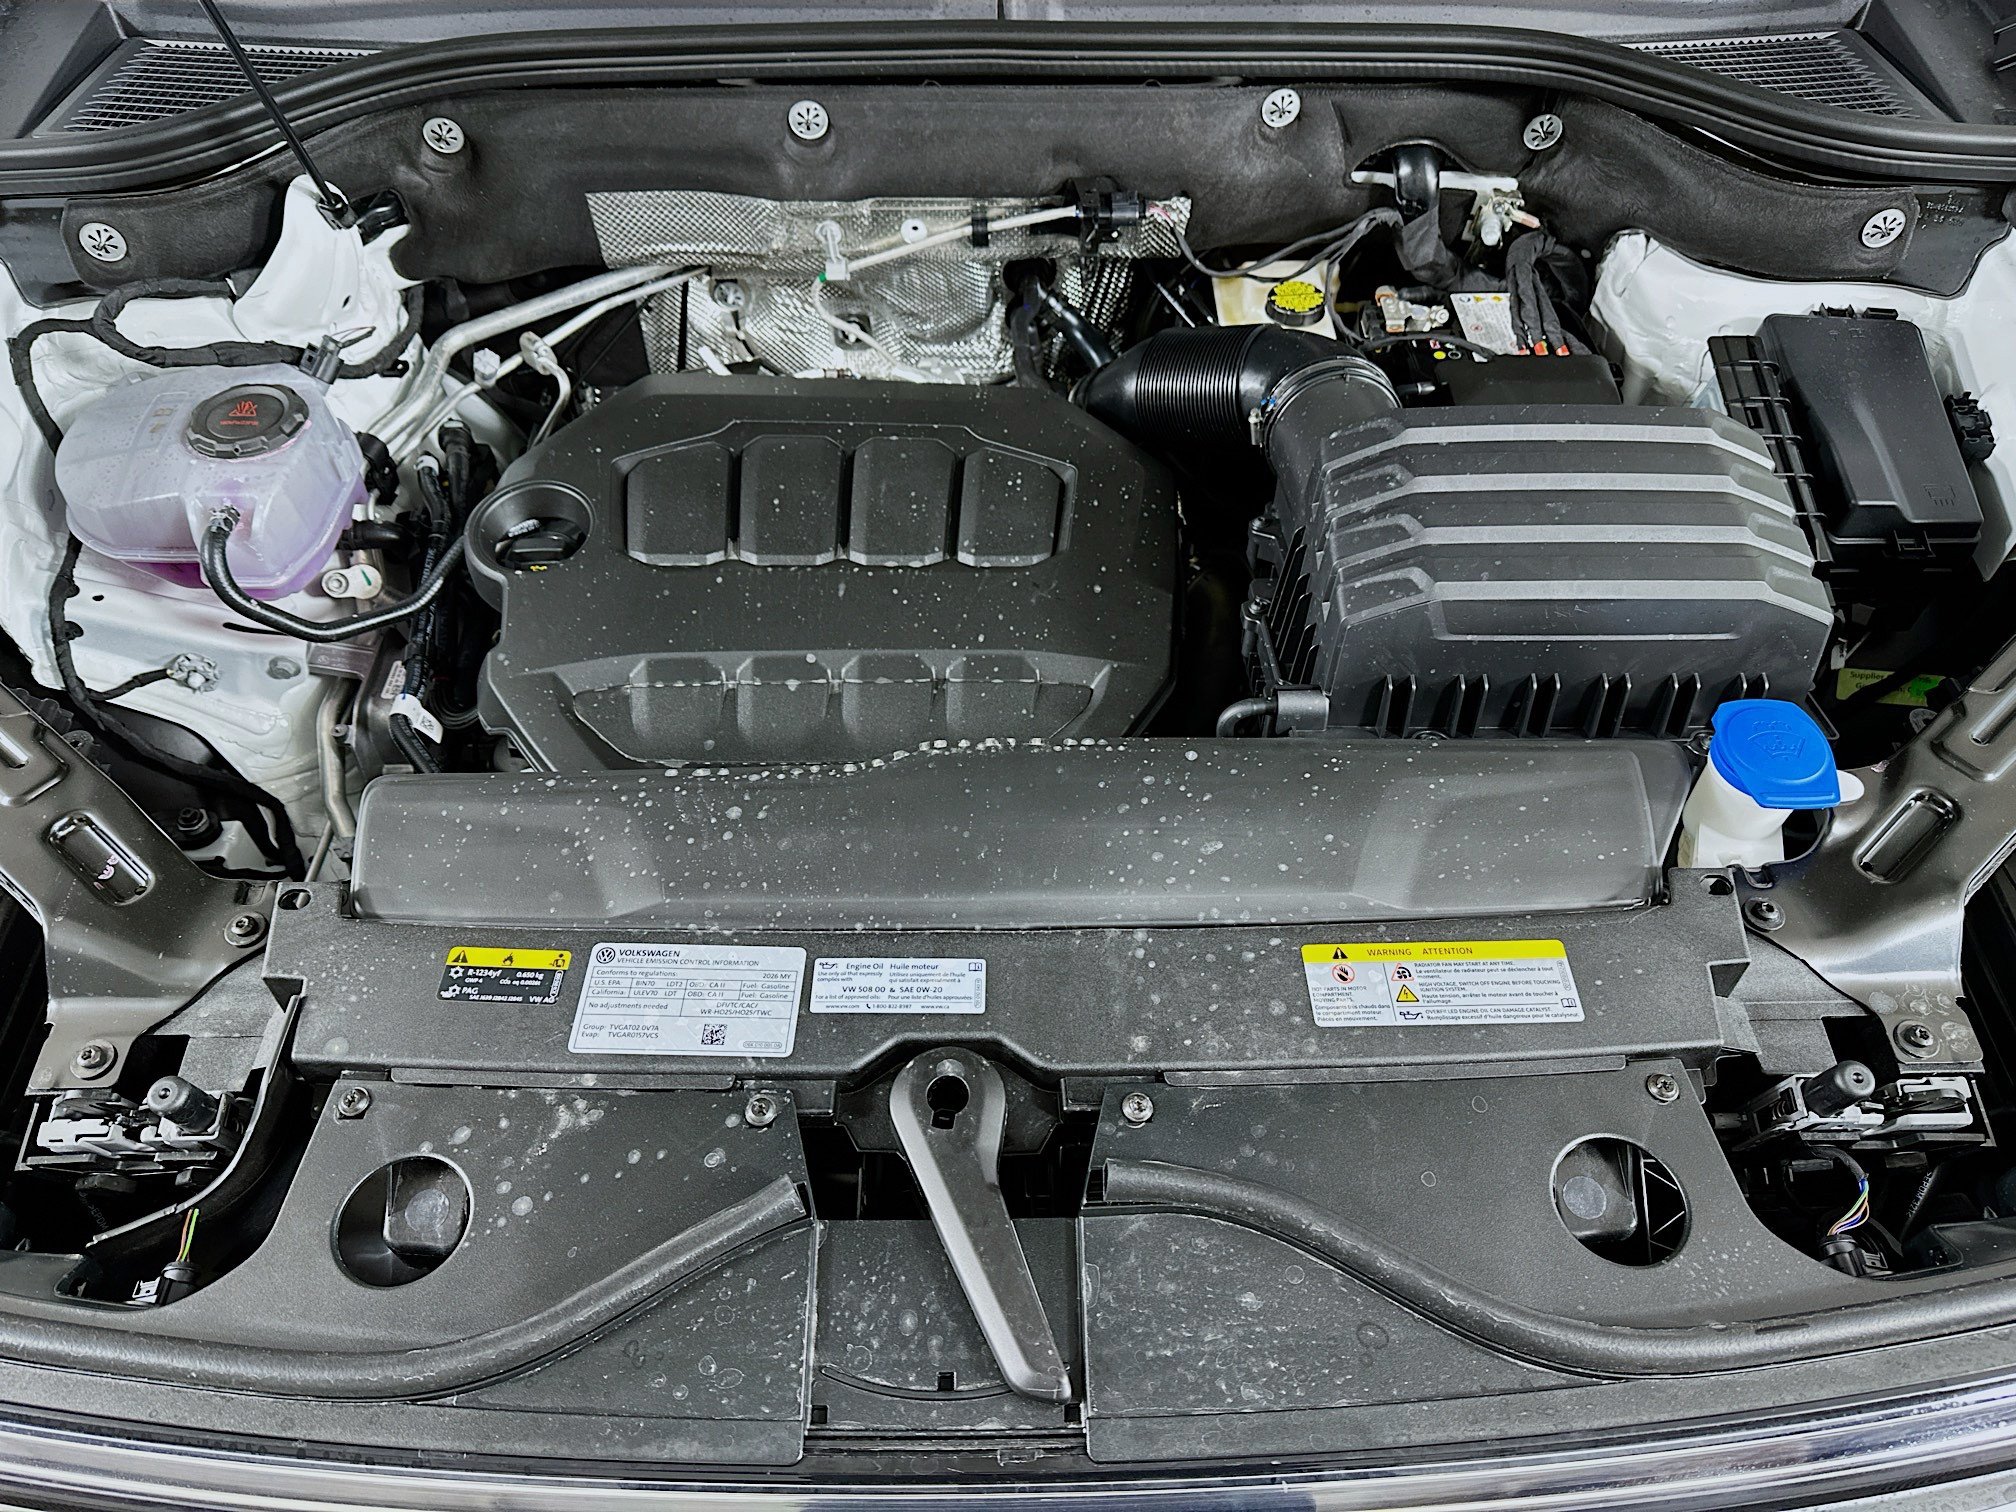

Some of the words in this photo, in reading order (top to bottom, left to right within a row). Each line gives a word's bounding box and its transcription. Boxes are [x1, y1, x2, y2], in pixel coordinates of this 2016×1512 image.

[619, 949, 681, 957] VOLKSWAGEN
[1367, 948, 1412, 956] WARNING
[1422, 947, 1473, 955] ATTENTION
[846, 962, 872, 971] Engine
[467, 969, 502, 978] R-1234yf
[535, 972, 544, 980] kg
[761, 981, 790, 990] Gasoline
[529, 996, 544, 1004] VW
[543, 996, 556, 1004] AG
